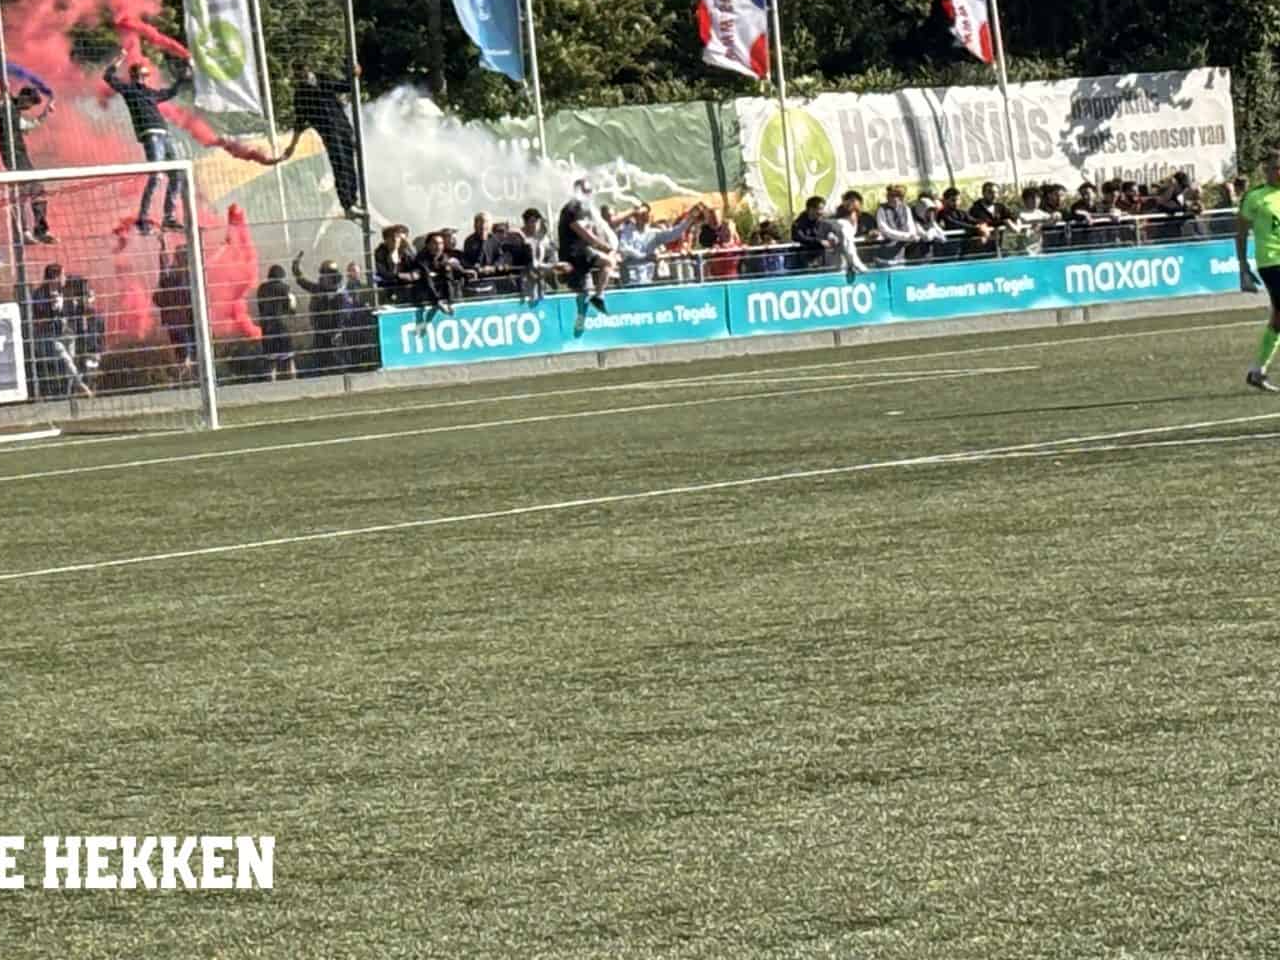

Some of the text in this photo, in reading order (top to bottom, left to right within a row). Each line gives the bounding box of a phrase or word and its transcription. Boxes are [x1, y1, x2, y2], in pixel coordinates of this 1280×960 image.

[1130, 127, 1196, 152] sponsor
[1198, 124, 1226, 146] van
[1065, 256, 1180, 293] maxaro
[747, 283, 872, 323] maxaro
[400, 312, 541, 354] maxaro
